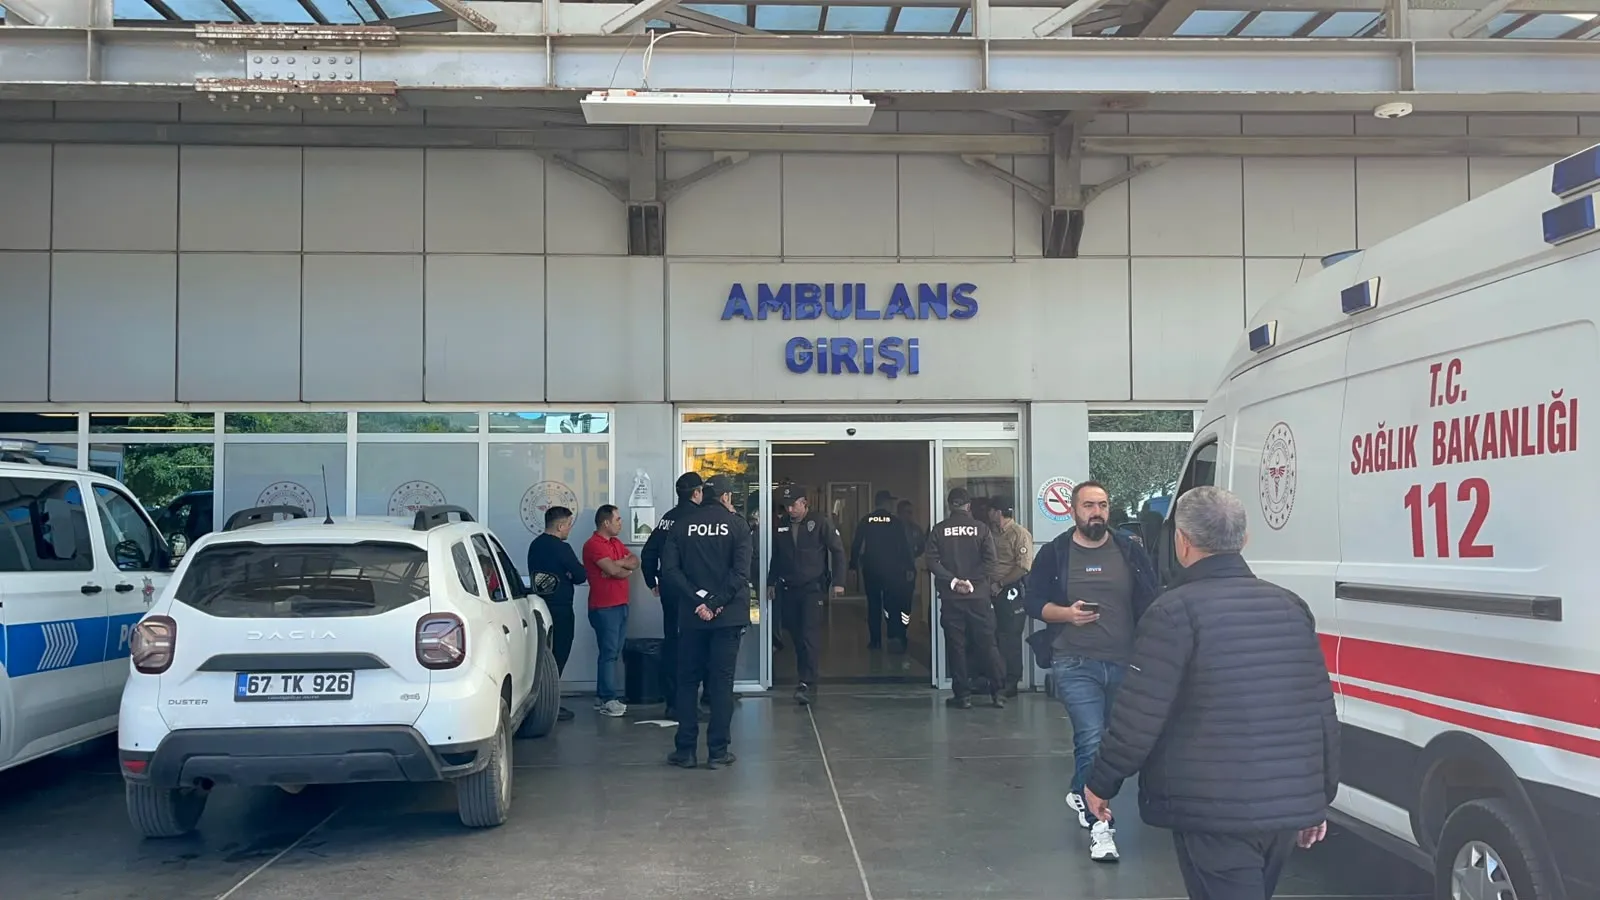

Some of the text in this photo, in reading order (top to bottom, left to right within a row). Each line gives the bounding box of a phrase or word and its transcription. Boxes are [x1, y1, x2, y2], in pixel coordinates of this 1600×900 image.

[720, 282, 979, 321] AMBULANS
[785, 336, 921, 379] GİRİŞİ
[1428, 358, 1468, 408] T.C.
[1350, 420, 1419, 476] SAĞLIK
[1431, 387, 1579, 467] BAKANLIĞI
[1403, 477, 1495, 559] 112
[247, 630, 337, 641] DACIA
[168, 698, 209, 706] DUSTER
[247, 675, 272, 694] 67
[281, 674, 304, 693] TK
[313, 674, 349, 693] 926
